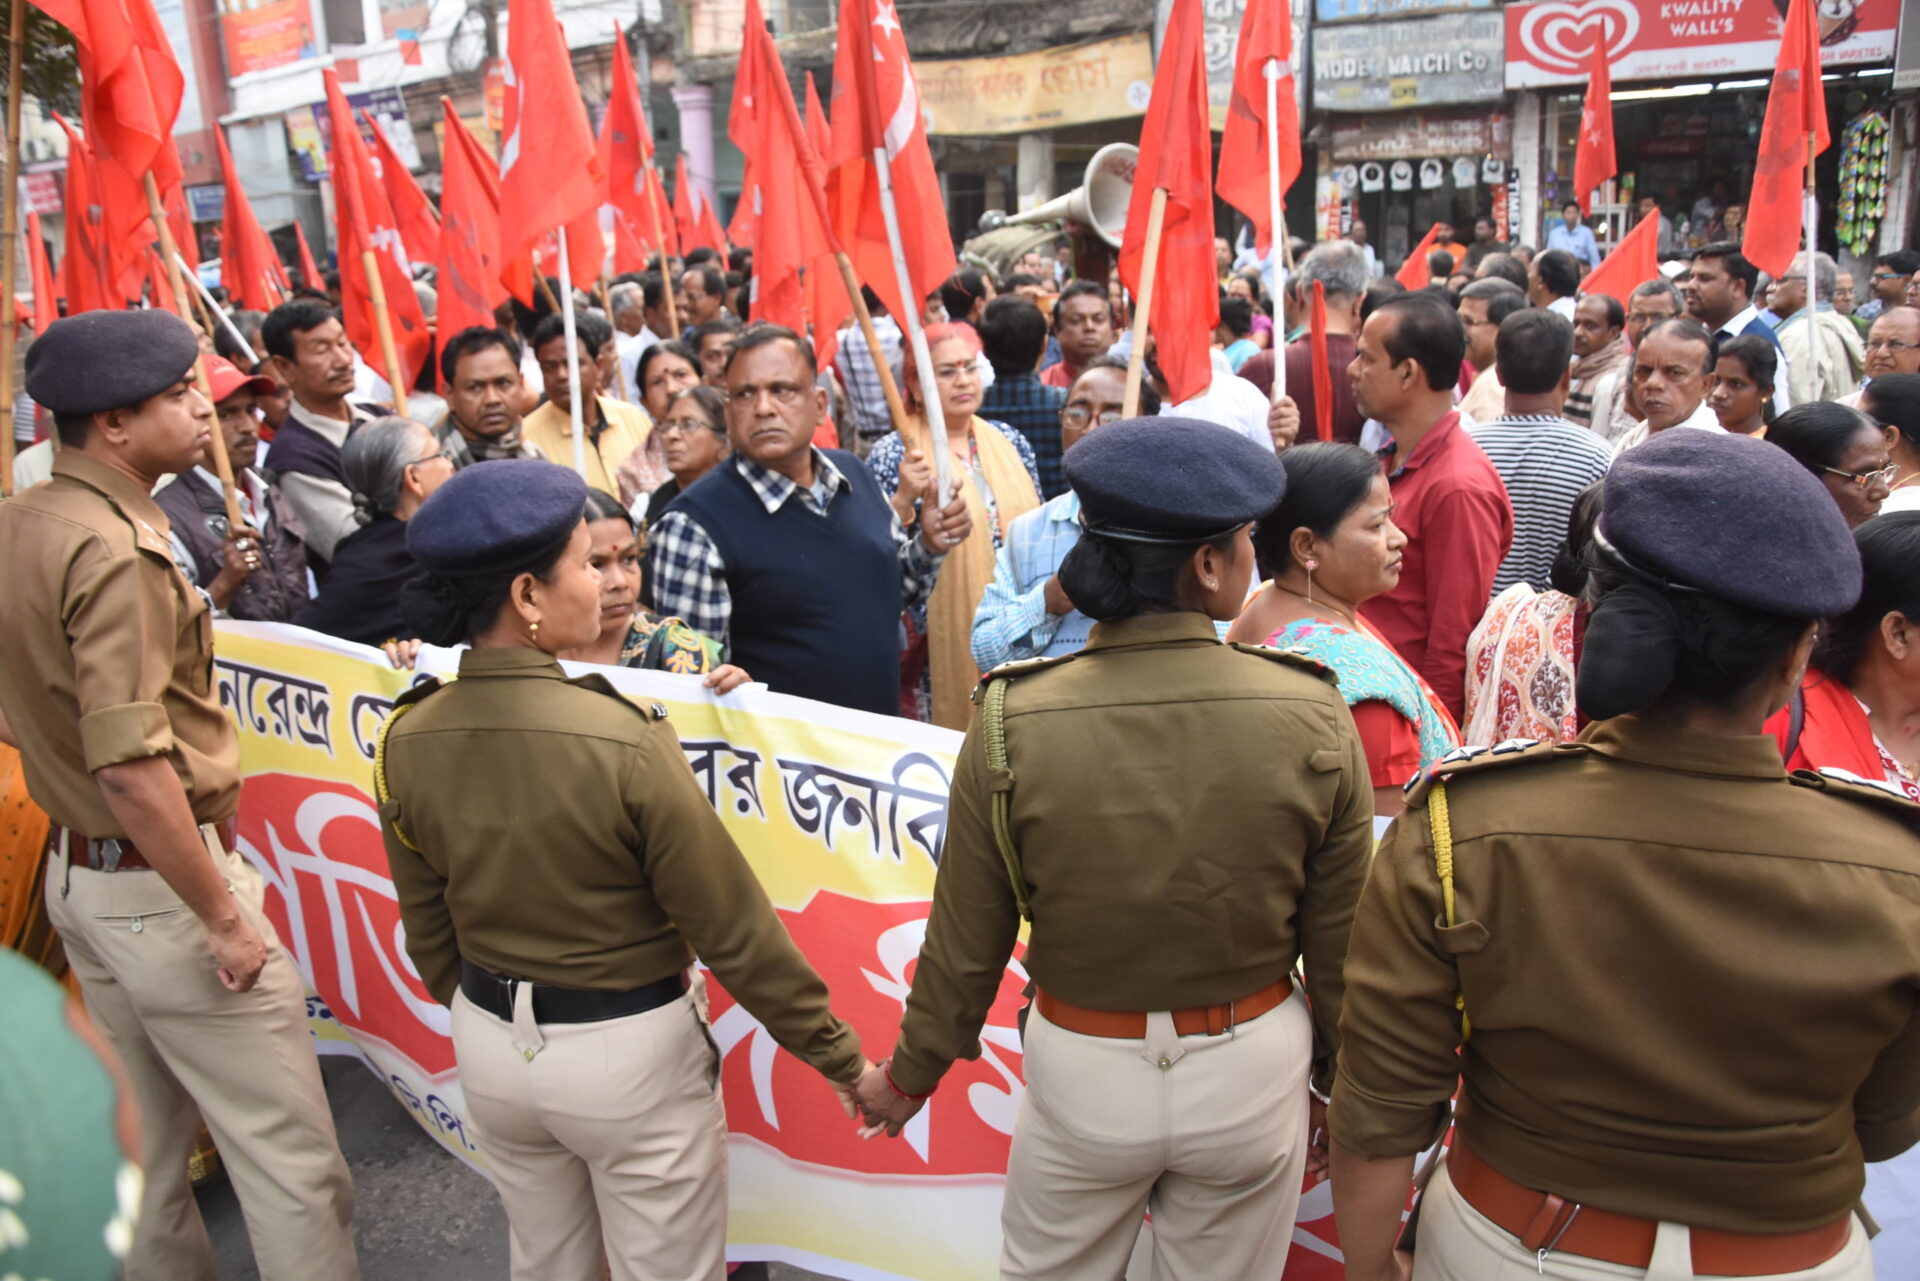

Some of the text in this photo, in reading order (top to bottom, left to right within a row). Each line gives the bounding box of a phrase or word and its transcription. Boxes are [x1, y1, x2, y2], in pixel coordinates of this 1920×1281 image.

[1661, 0, 1745, 19] KWALITY
[1670, 18, 1735, 37] WALL'S
[1508, 178, 1520, 233] TIMEX
[213, 658, 333, 758] নরেন্দ্র
[776, 752, 951, 867] জনবি
